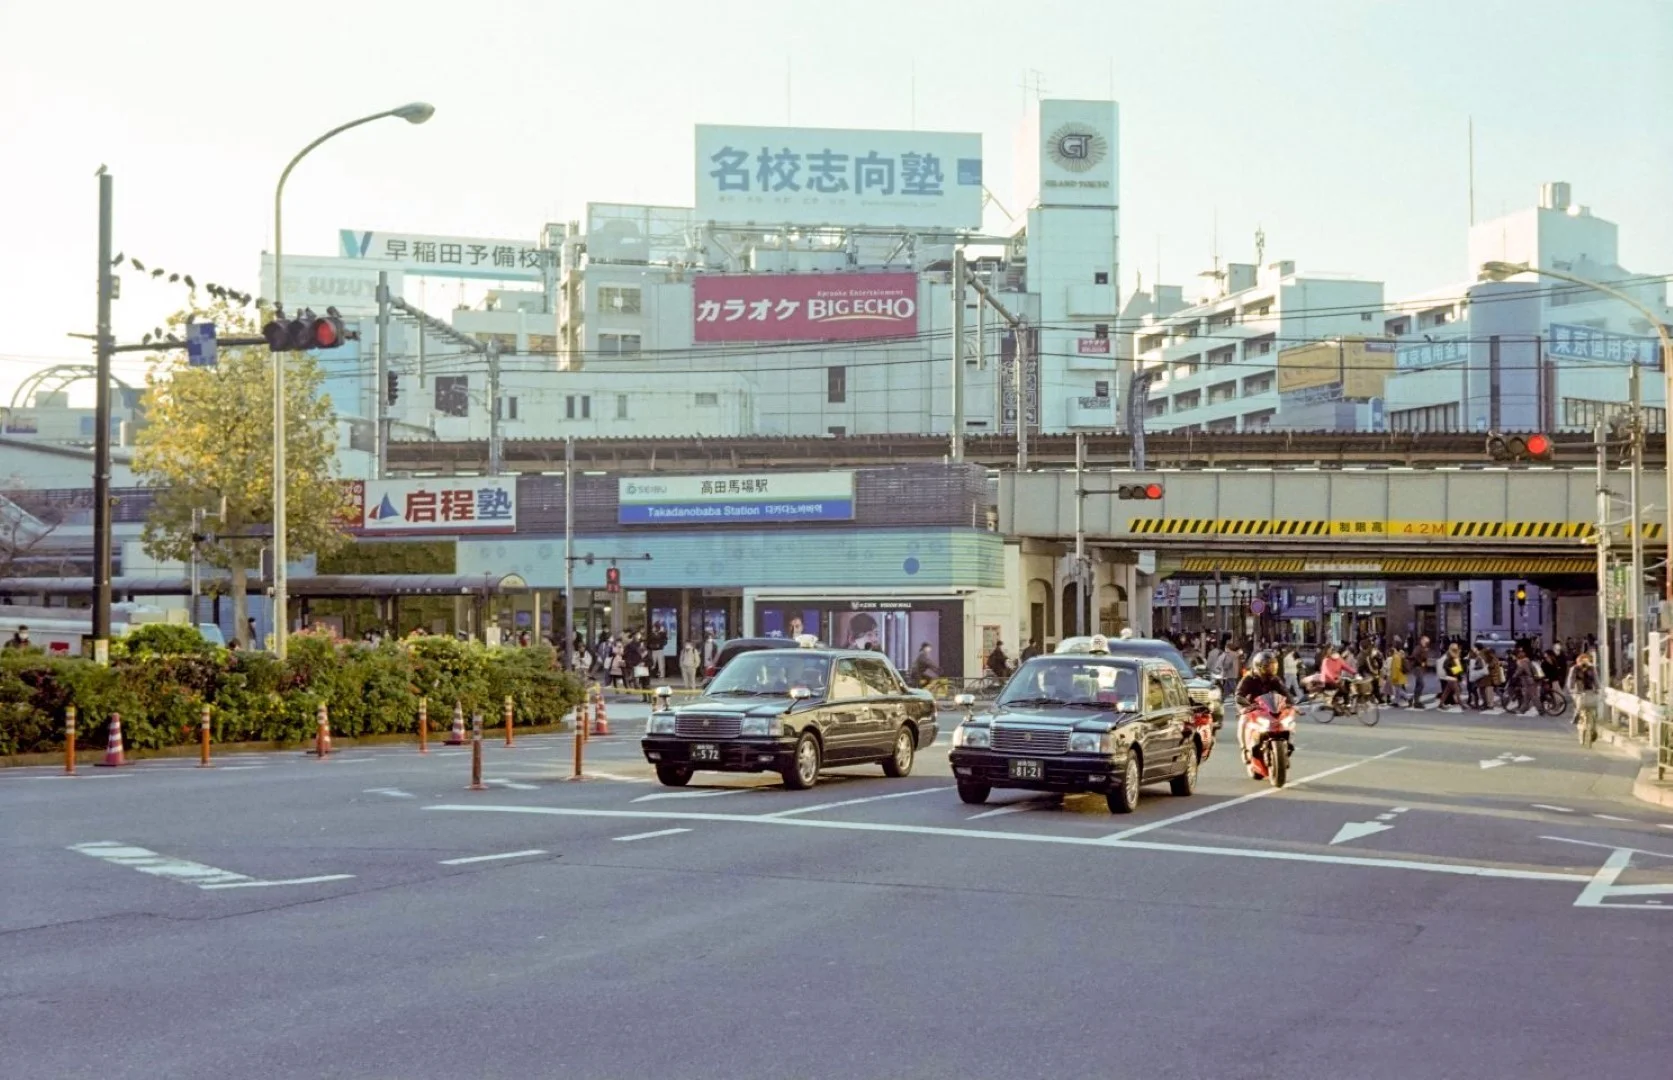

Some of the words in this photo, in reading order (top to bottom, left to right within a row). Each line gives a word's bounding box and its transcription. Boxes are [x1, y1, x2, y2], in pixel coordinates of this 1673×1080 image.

[710, 146, 944, 196] 名校志向塾
[850, 289, 904, 297] Entertainment
[696, 299, 800, 322] カラオケ
[808, 298, 849, 320] BIG
[853, 297, 915, 319] ECHO
[701, 479, 768, 495] 高田馬場駅
[404, 487, 513, 523] 启程塾
[647, 505, 721, 518] Takadanobaba
[723, 504, 760, 516] Station
